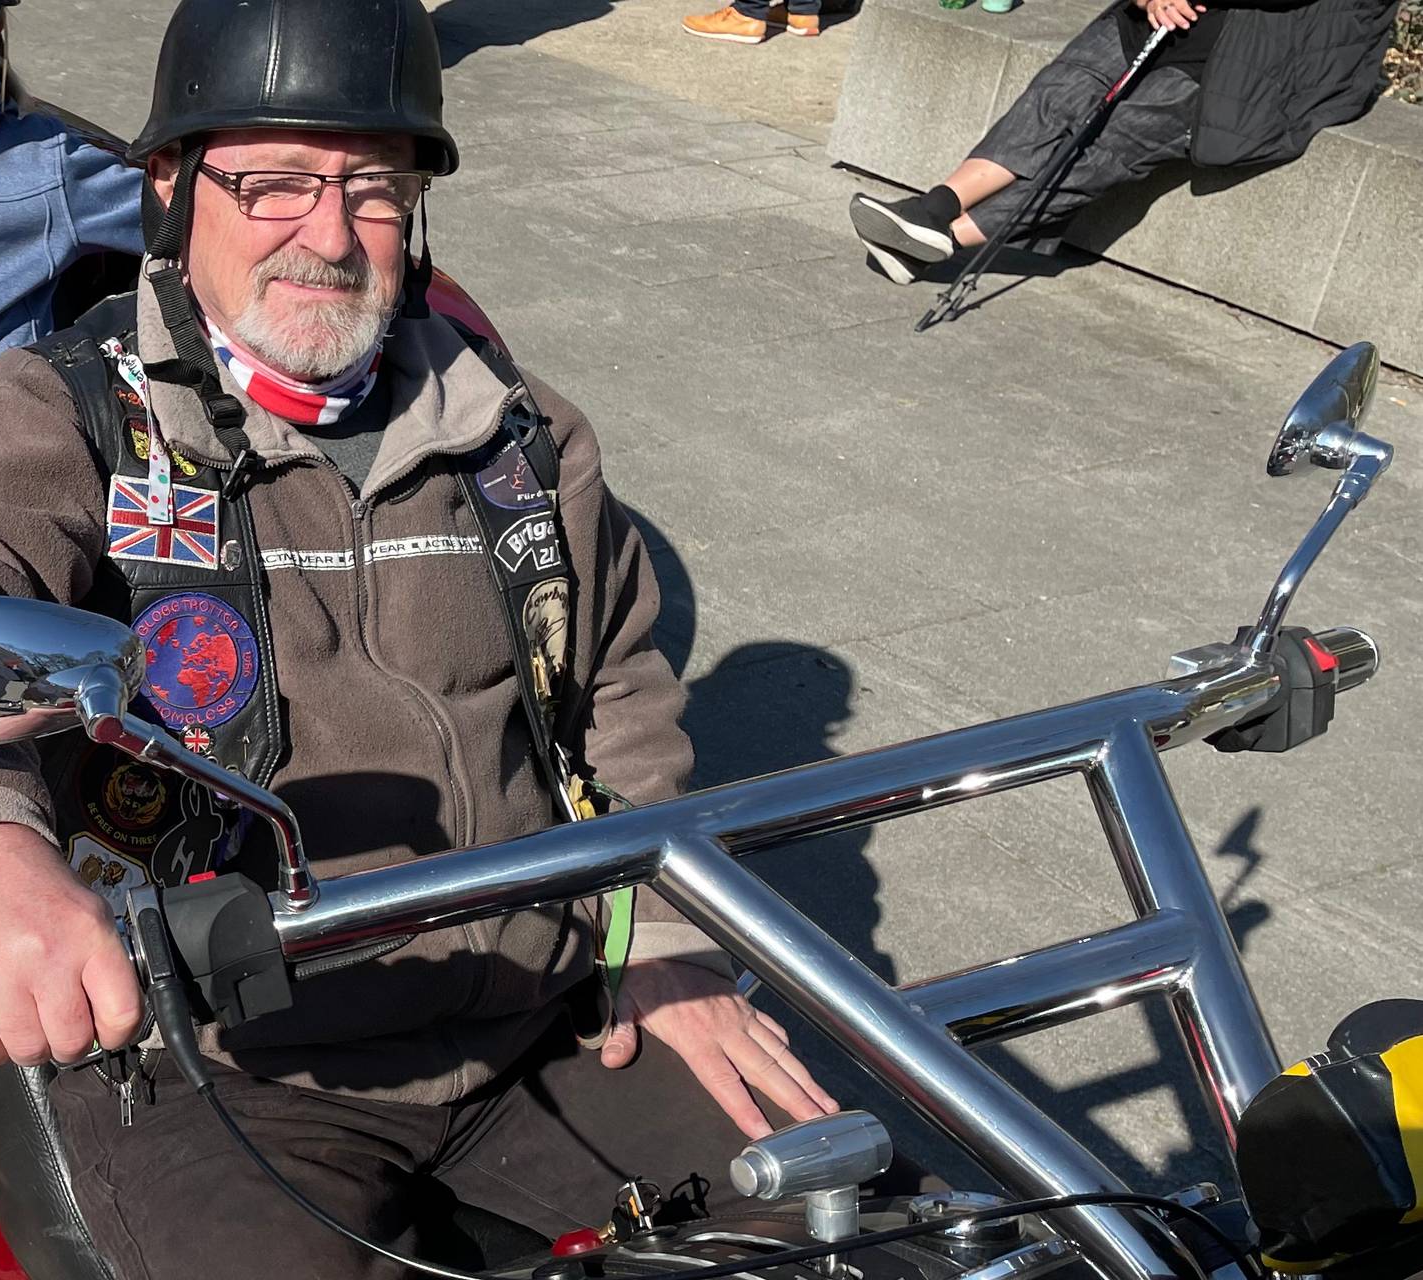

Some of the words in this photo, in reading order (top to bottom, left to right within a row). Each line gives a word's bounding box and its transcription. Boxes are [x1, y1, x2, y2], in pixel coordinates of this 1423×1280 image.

[137, 598, 240, 637] GLOBETROTTER
[93, 814, 114, 835] FREE
[113, 830, 129, 844] ON
